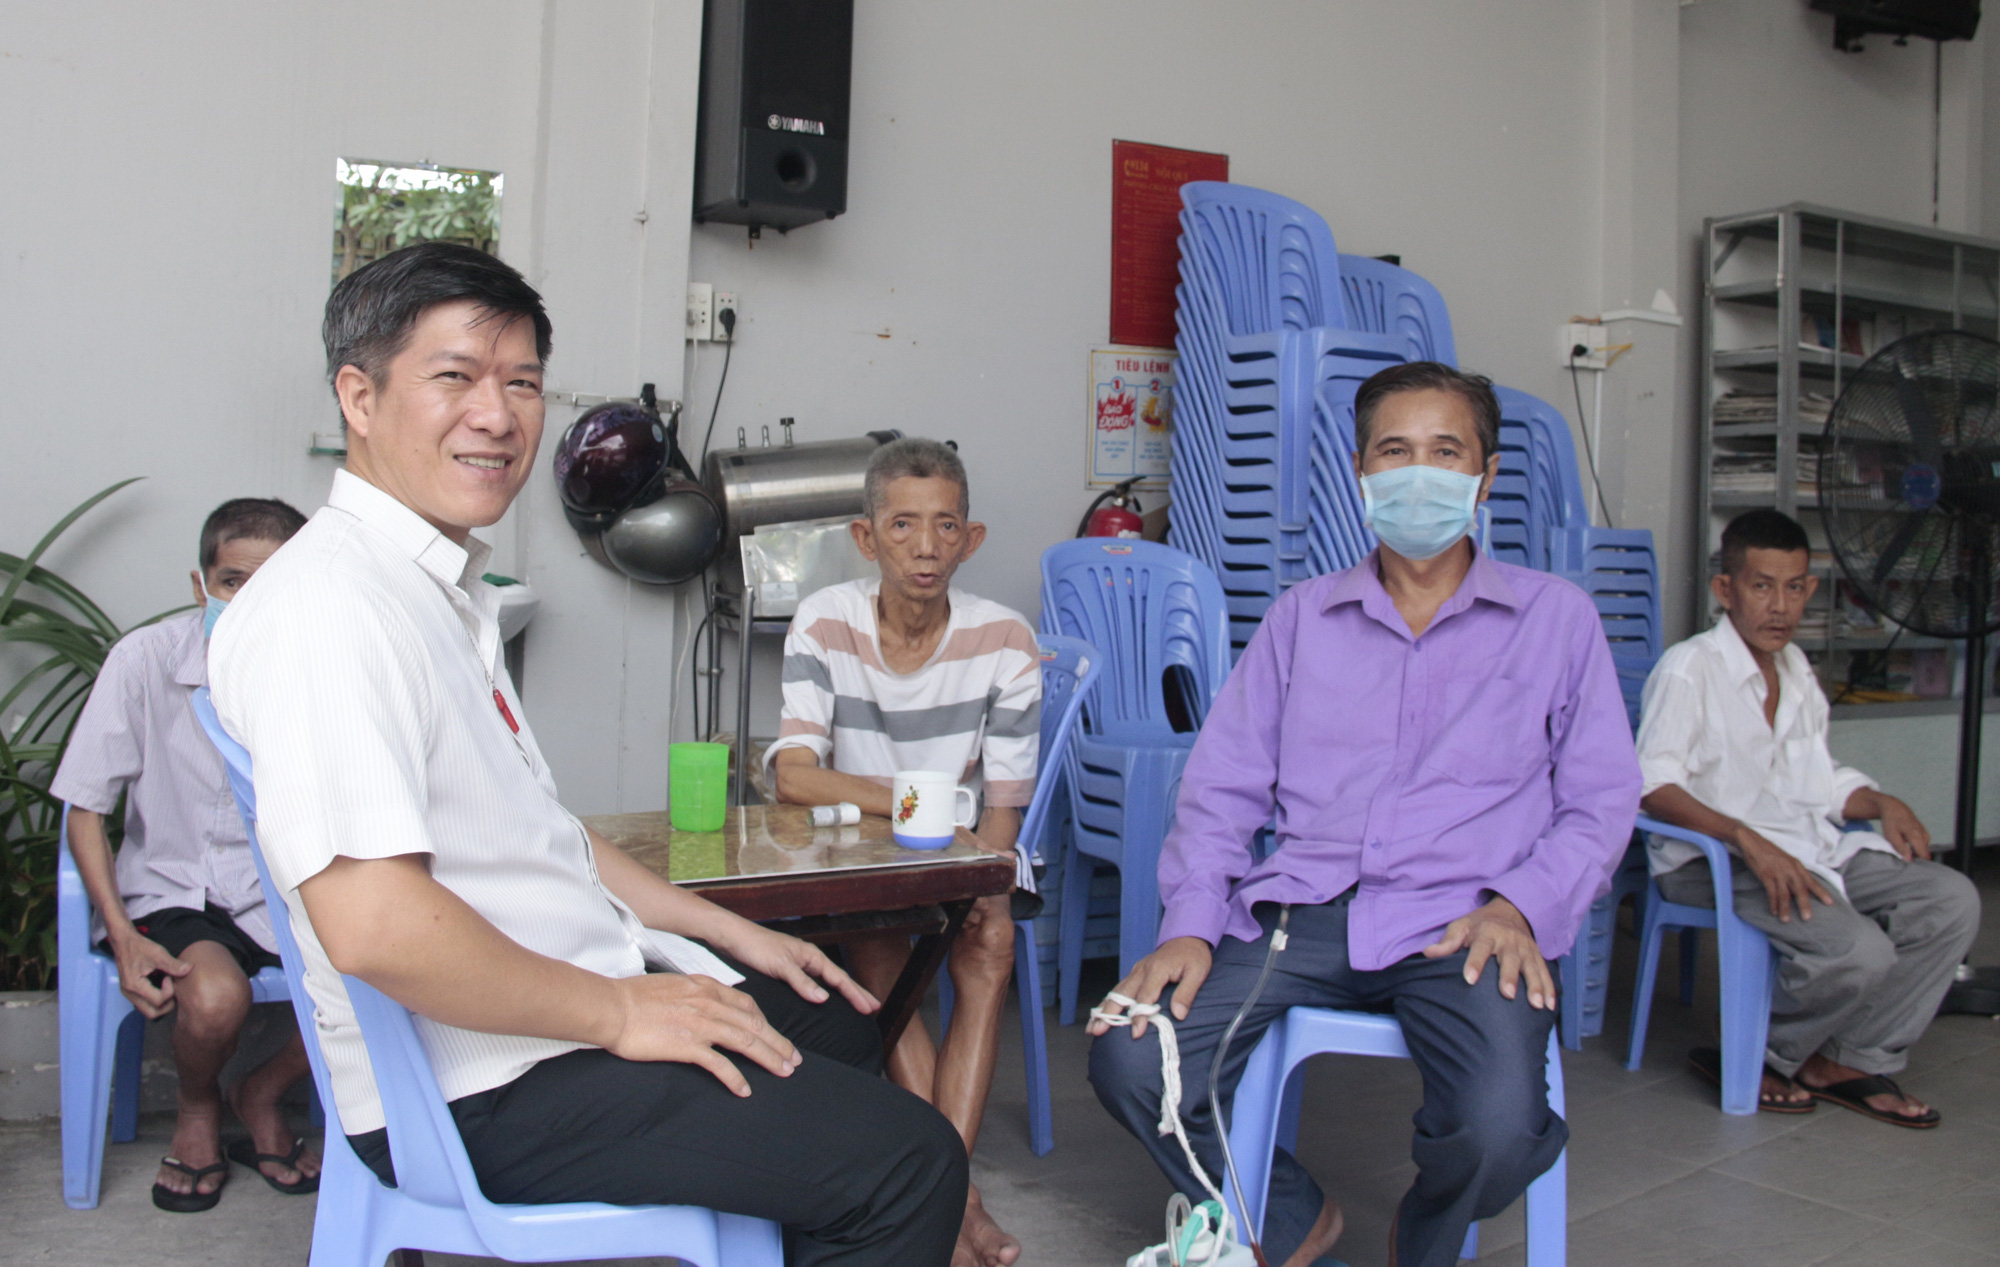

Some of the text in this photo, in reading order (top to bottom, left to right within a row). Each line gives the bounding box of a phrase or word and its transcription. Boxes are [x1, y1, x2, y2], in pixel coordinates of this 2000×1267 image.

[782, 116, 824, 136] YAMAHA
[1116, 358, 1170, 373] TIÊU LỆNH
[1114, 380, 1120, 390] 1
[1152, 380, 1160, 391] 2
